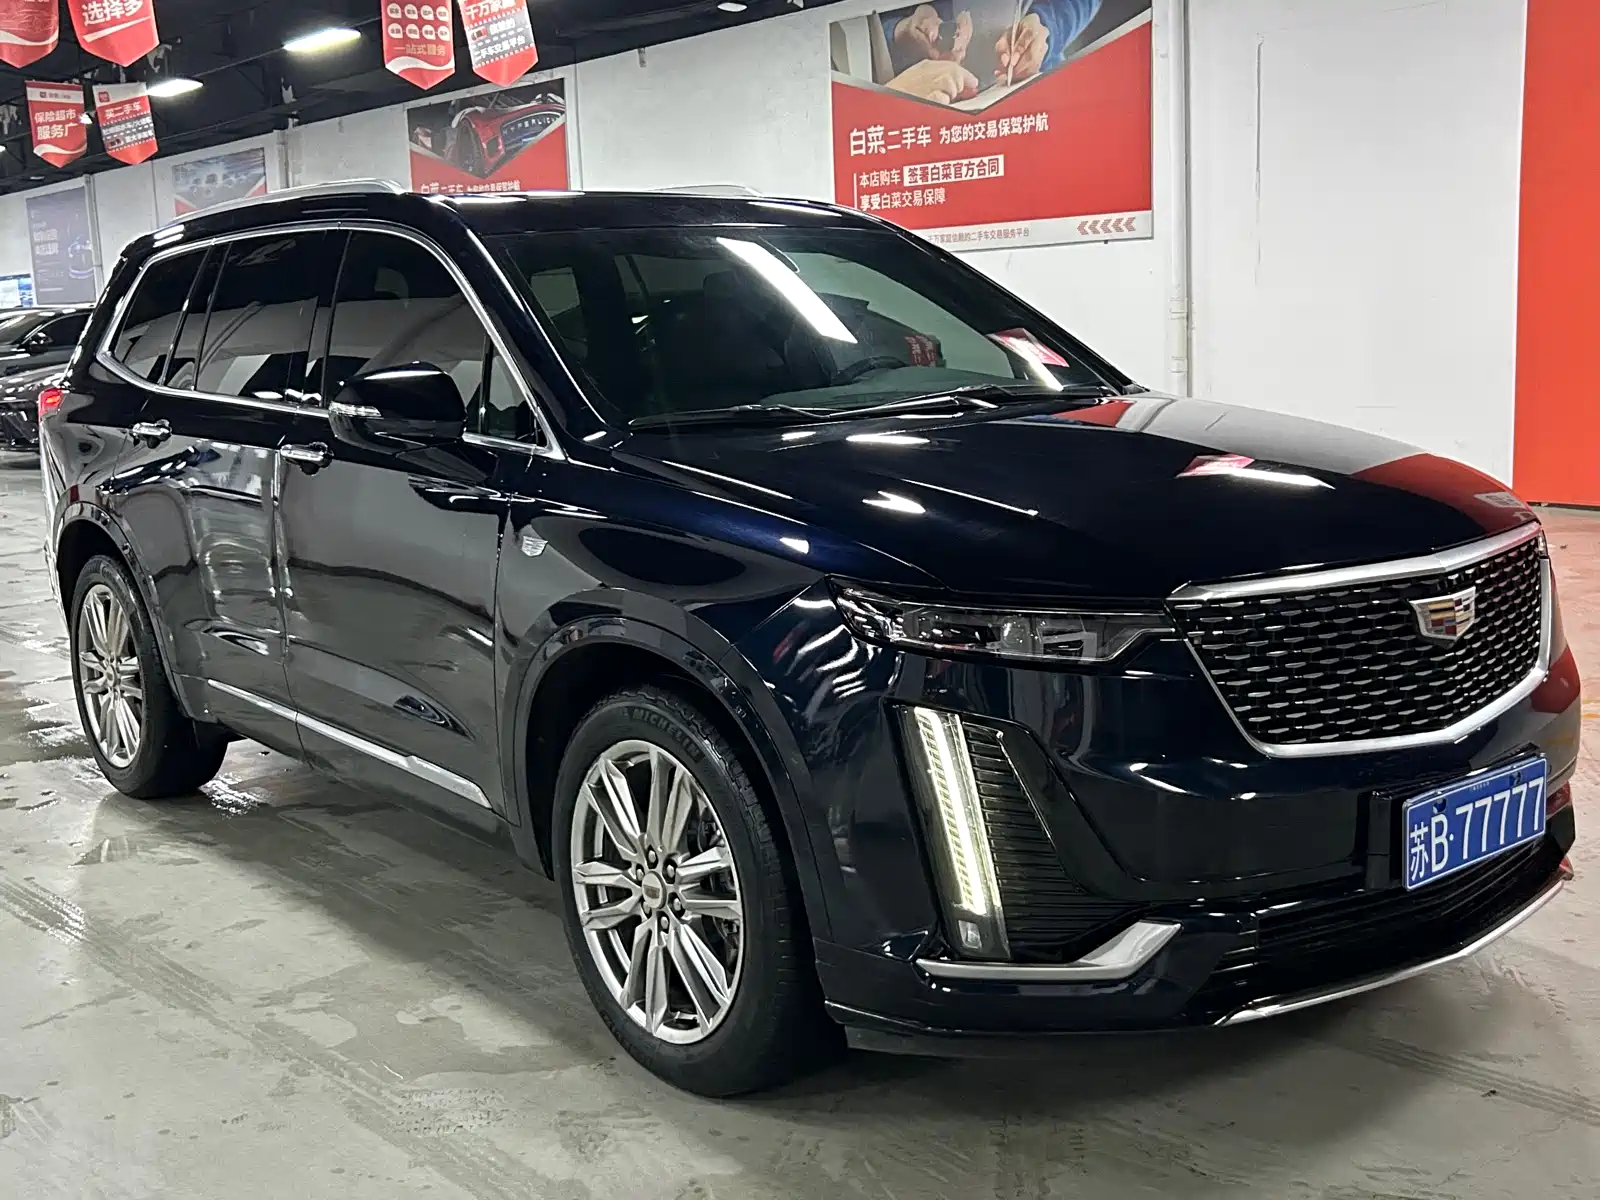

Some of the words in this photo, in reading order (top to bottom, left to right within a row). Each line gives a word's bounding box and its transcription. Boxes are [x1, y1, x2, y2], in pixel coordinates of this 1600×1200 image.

[82, 0, 144, 26] 选择多
[34, 108, 77, 124] 保险超市
[850, 124, 932, 157] 白菜二手车
[939, 112, 1049, 145] 为您的交易保驾护航
[859, 169, 901, 188] 本店购车
[907, 157, 1000, 184] 签署白菜官方合同
[860, 187, 946, 212] 享受白菜交易保障
